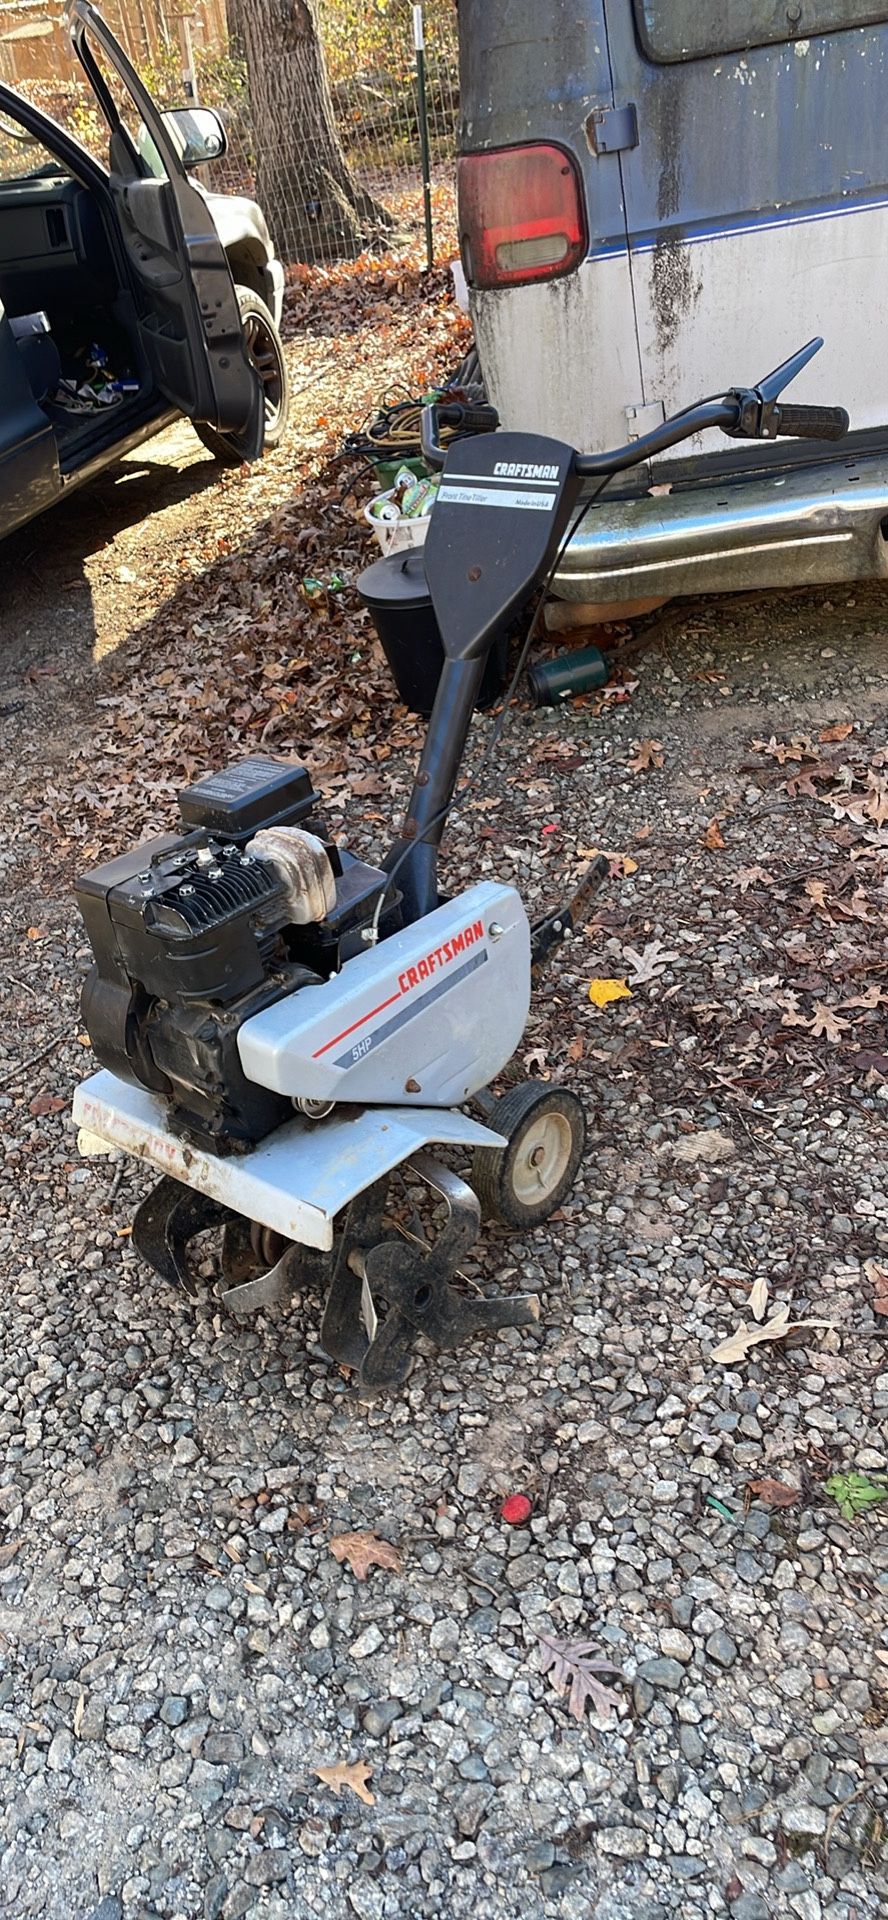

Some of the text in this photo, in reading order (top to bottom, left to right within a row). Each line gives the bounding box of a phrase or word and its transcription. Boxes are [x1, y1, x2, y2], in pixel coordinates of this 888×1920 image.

[493, 462, 559, 479] CRAFTSMAN
[442, 491, 459, 500] Front
[397, 920, 485, 994] CRAFTSMAN
[351, 1037, 373, 1061] 5HP
